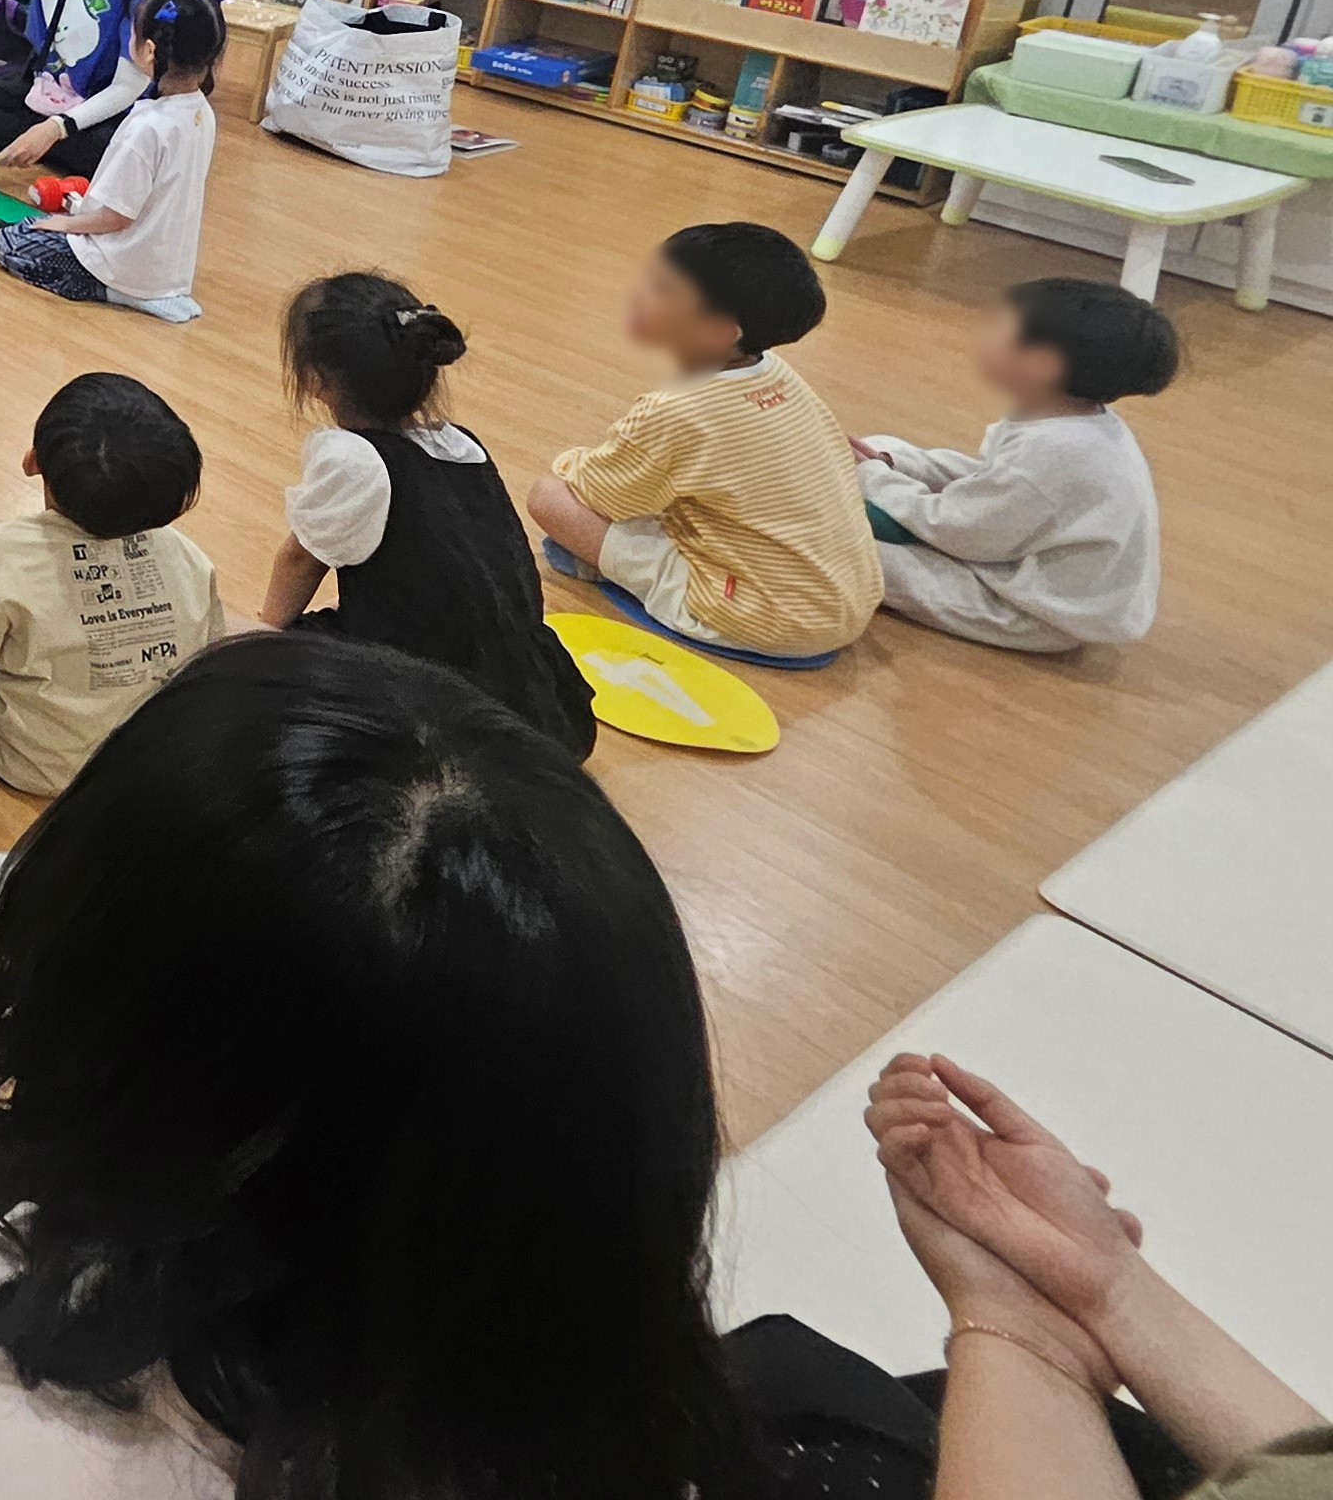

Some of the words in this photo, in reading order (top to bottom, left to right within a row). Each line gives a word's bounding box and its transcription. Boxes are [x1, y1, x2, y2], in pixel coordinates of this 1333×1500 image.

[374, 60, 442, 75] PASSION
[343, 92, 355, 103] is
[357, 95, 380, 104] not
[382, 92, 407, 108] just
[408, 91, 441, 106] rising
[321, 102, 344, 117] but
[344, 109, 385, 120] never
[384, 109, 426, 124] giving
[80, 613, 107, 626] Love
[117, 602, 173, 620] Everywhere
